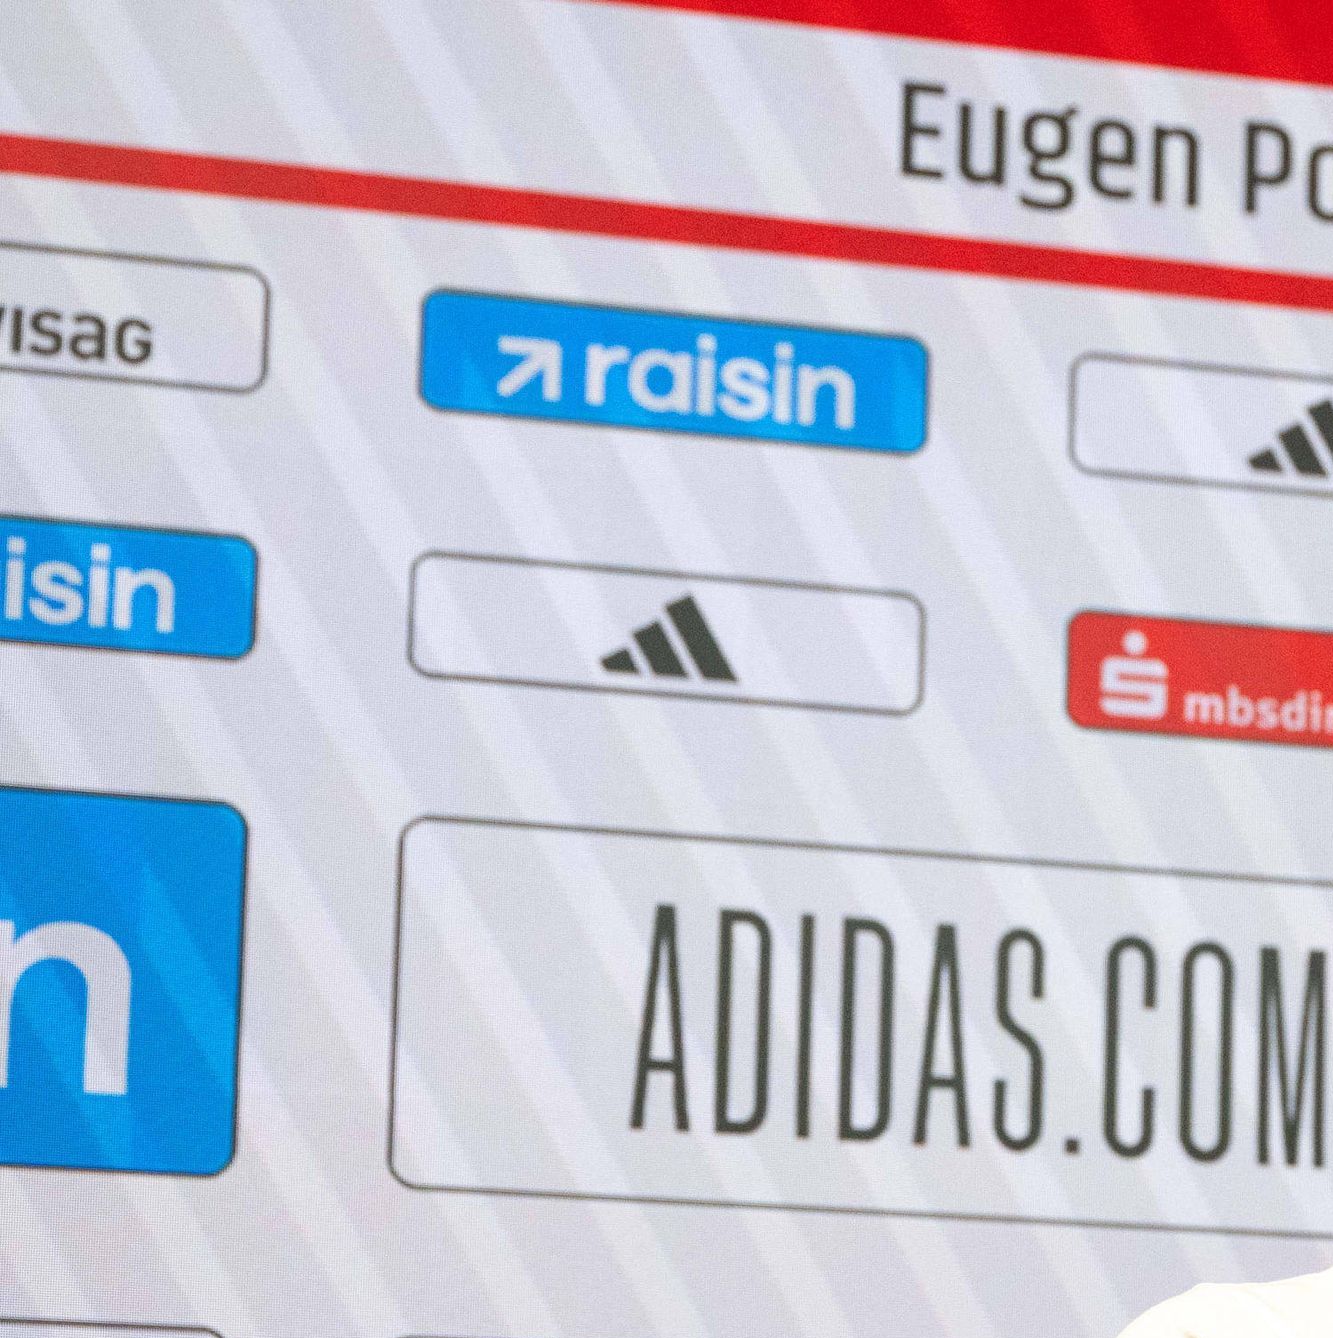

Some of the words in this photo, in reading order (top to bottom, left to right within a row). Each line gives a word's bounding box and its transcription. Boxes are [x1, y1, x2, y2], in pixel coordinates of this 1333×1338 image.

[901, 81, 1201, 212] Eugen
[584, 334, 856, 431] raisin
[629, 902, 1328, 1169] ADIDAS.COM
